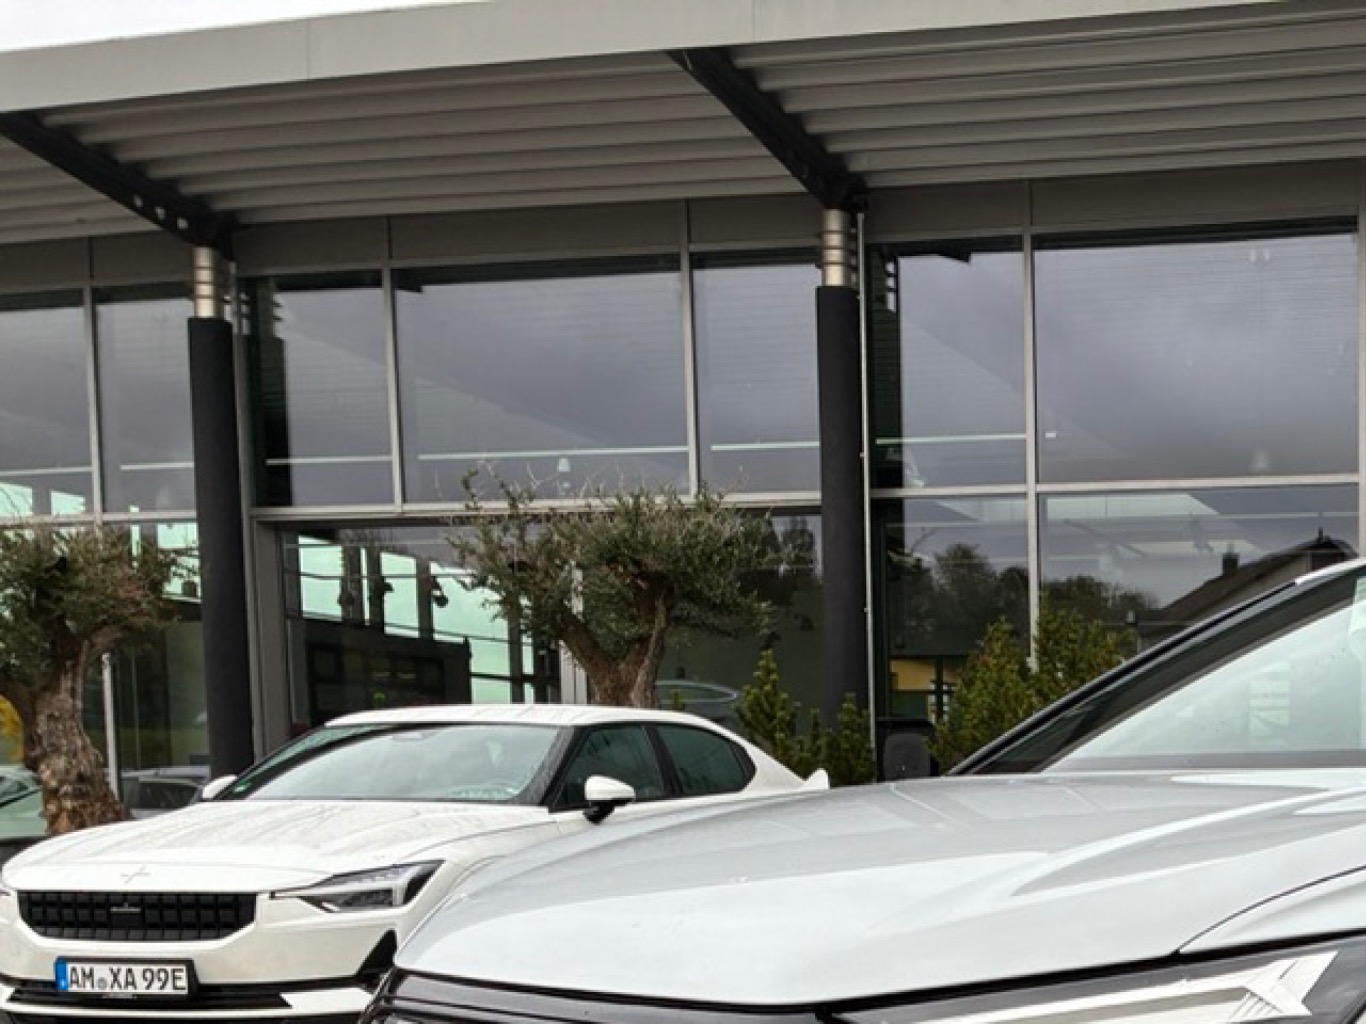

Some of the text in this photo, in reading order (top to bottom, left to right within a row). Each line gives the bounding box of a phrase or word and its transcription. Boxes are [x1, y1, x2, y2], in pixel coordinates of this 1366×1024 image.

[69, 966, 187, 991] AM XA 99E
